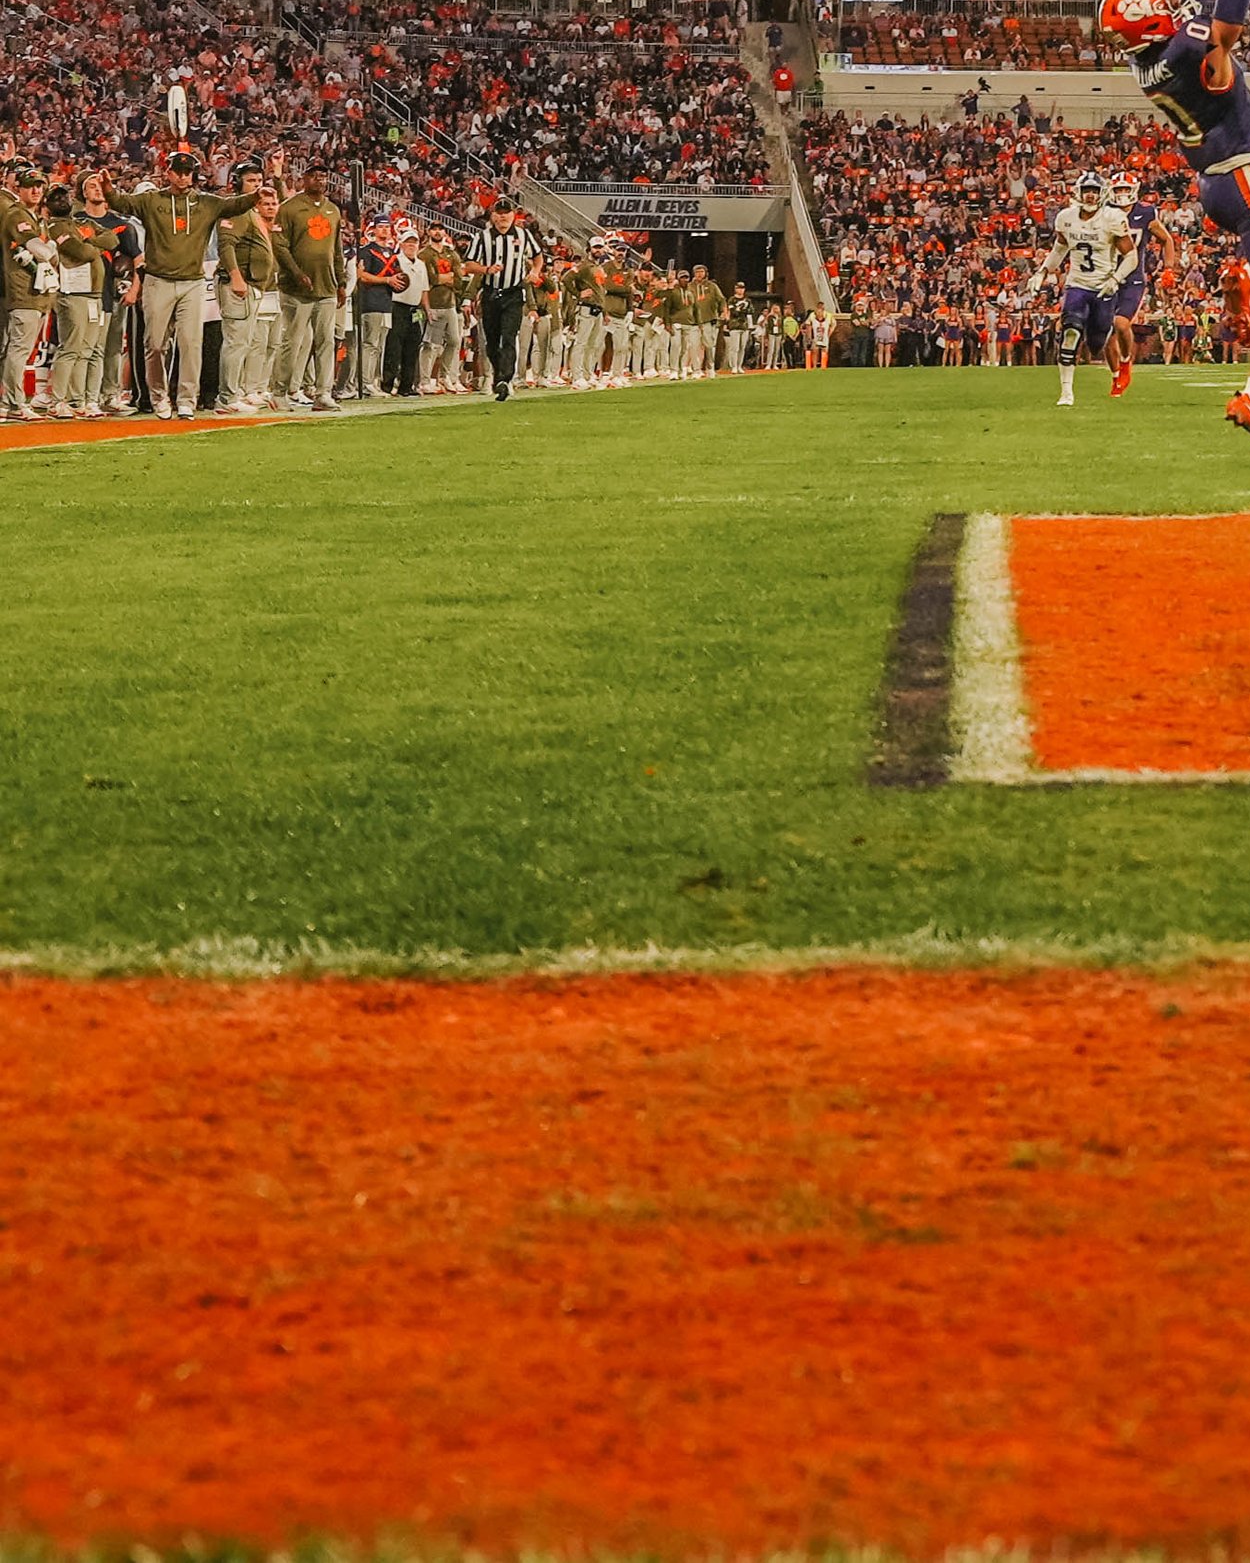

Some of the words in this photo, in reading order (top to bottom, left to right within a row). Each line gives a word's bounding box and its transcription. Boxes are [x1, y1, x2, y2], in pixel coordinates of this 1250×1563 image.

[1186, 21, 1211, 41] 0
[604, 199, 641, 213] ALLEN
[655, 200, 701, 214] REEVES
[598, 215, 662, 229] RECRUITING
[662, 216, 709, 229] CENTER
[1075, 242, 1095, 272] 3
